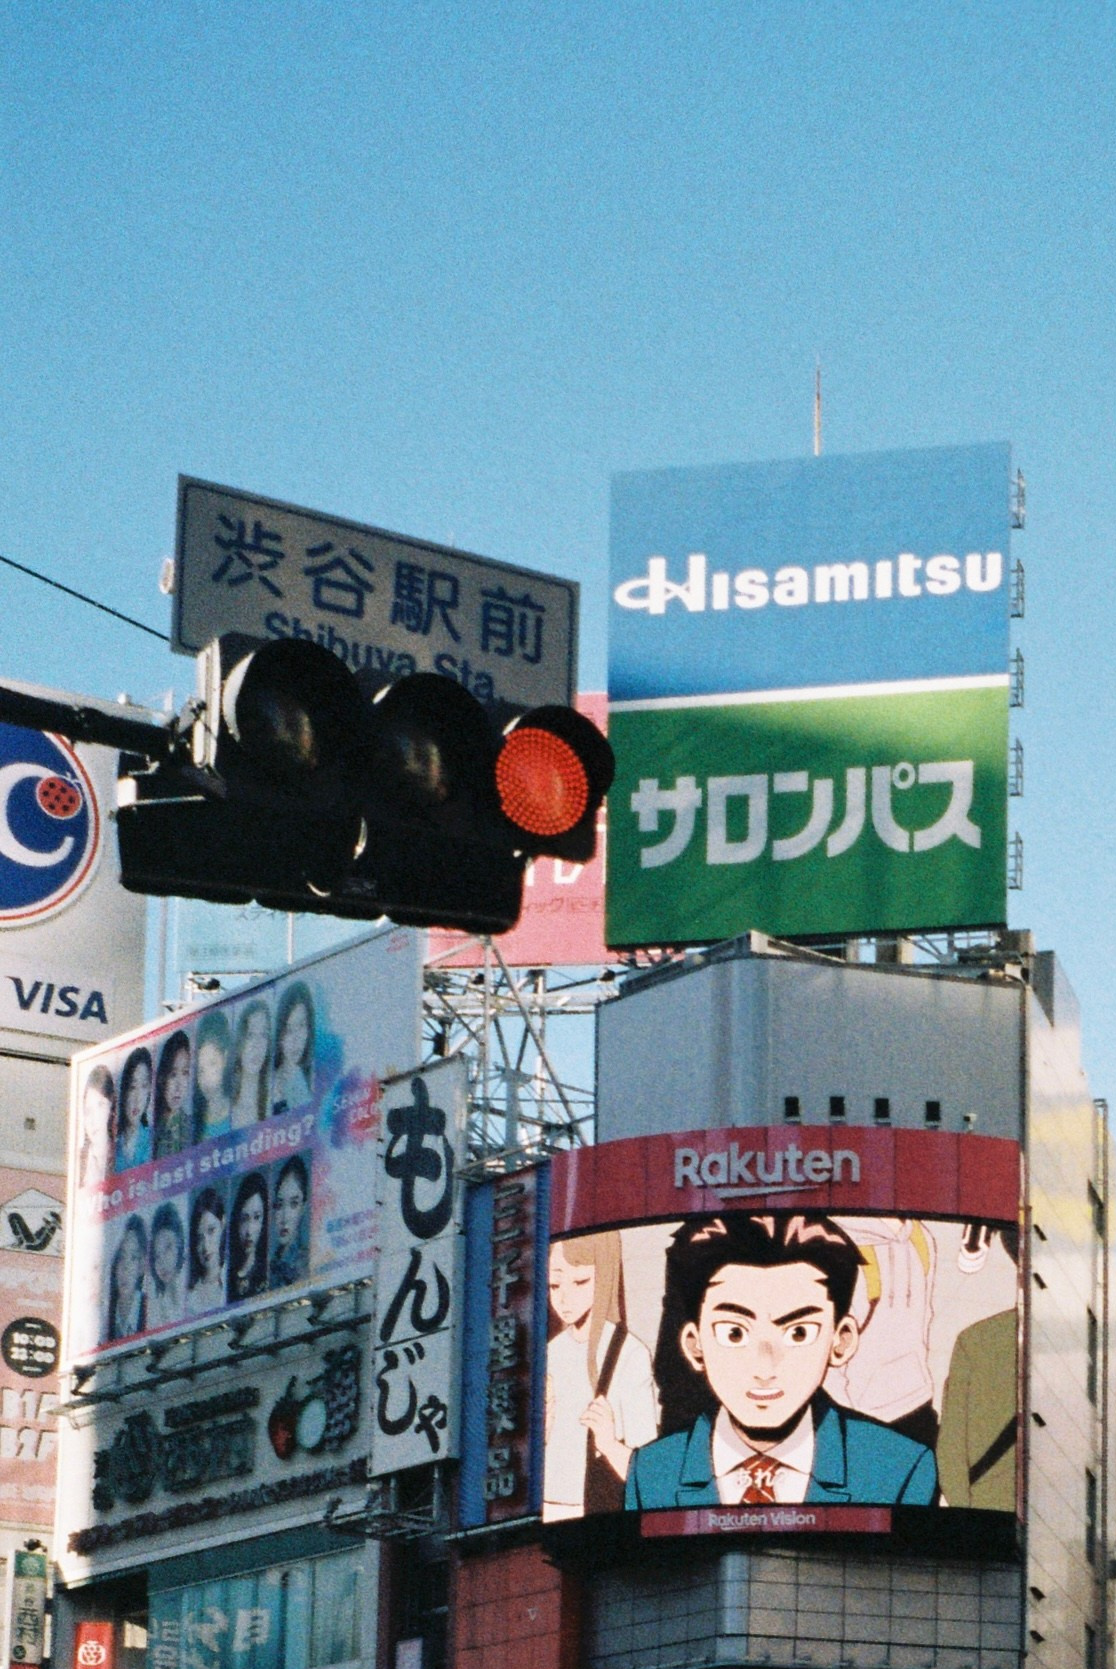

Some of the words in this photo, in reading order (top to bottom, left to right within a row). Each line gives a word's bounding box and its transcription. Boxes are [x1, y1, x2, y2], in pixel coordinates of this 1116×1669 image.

[211, 512, 547, 665] 渋谷駅前
[613, 553, 1003, 615] Hisamitsu
[630, 759, 982, 870] サロンパス
[6, 975, 109, 1025] VISA
[128, 1176, 148, 1200] is
[152, 1162, 195, 1191] last
[199, 1114, 315, 1174] standing?
[674, 1142, 861, 1191] Rakuten
[375, 1076, 456, 1454] もんじゃ
[708, 1512, 768, 1528] Rakuten
[770, 1511, 817, 1526] Vision
